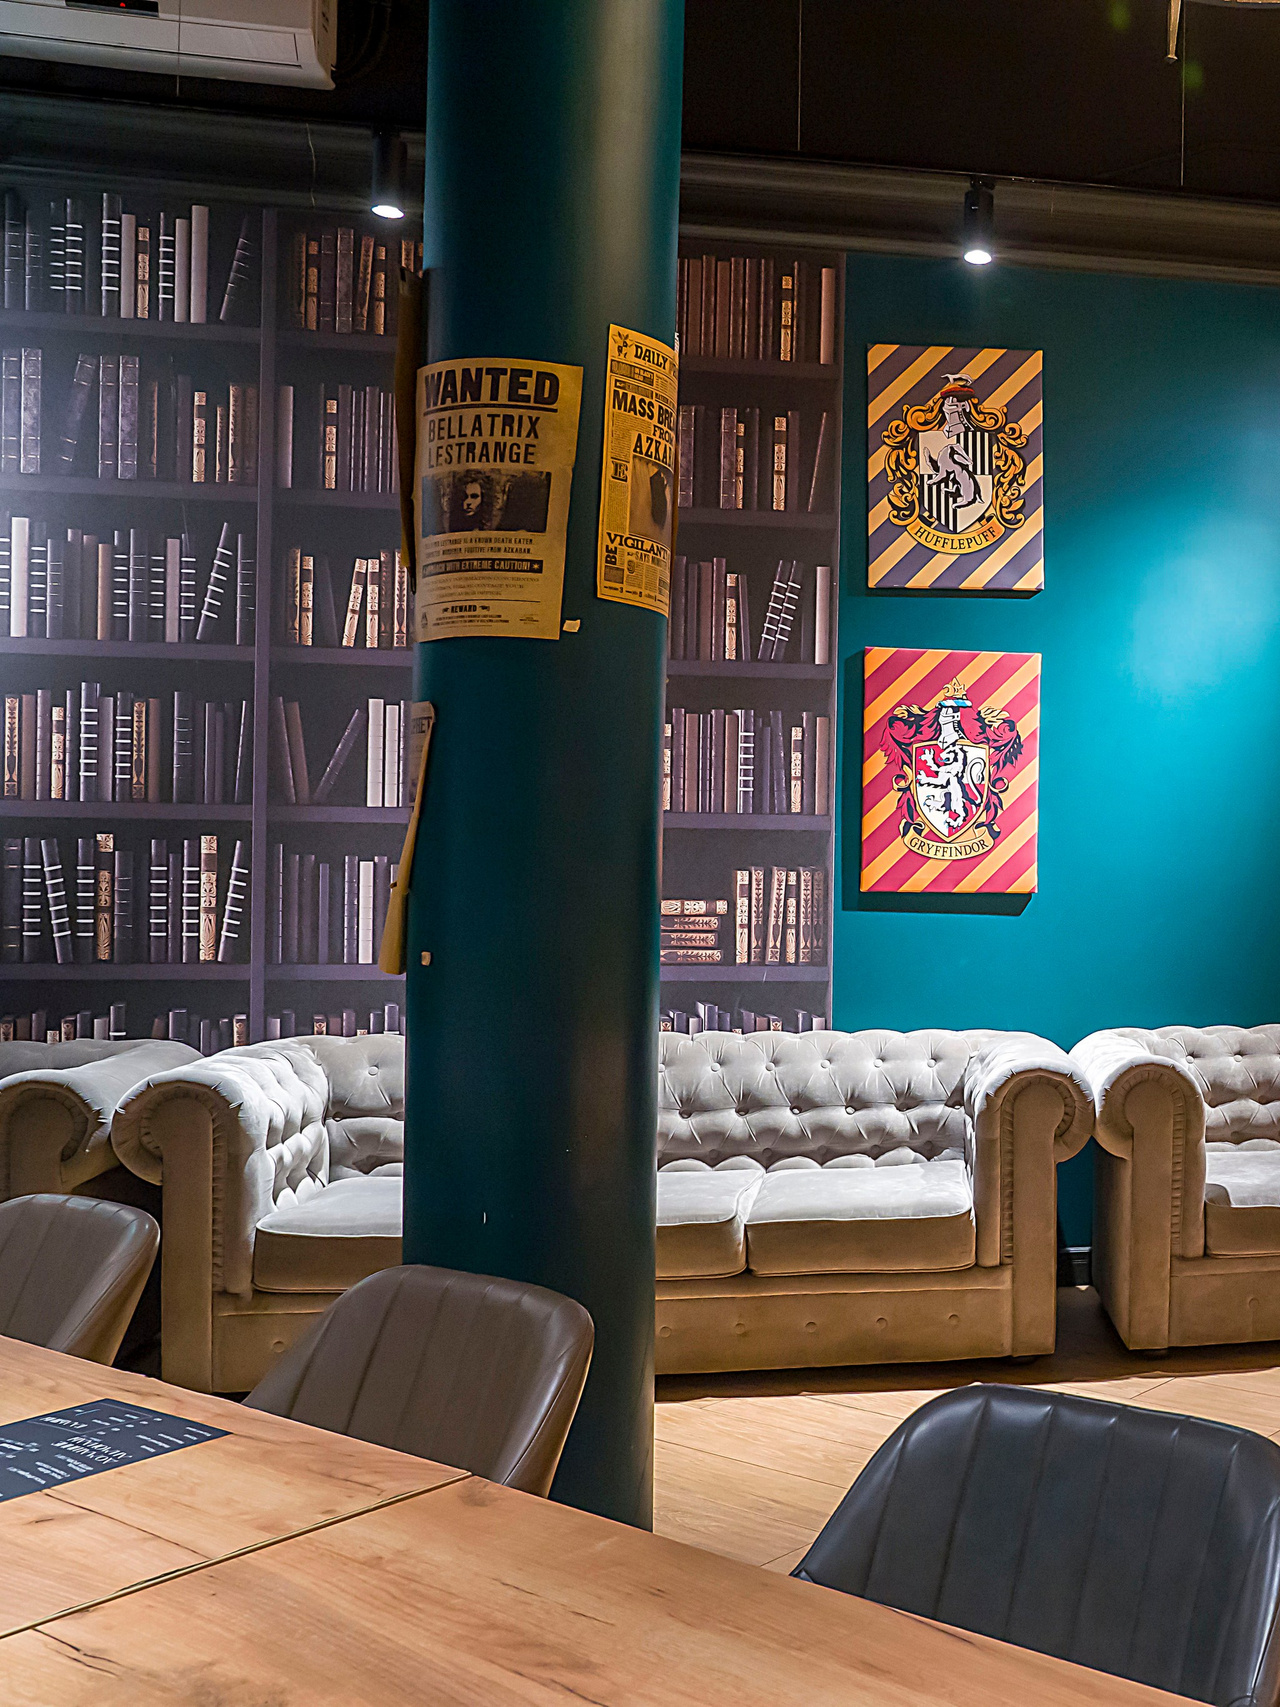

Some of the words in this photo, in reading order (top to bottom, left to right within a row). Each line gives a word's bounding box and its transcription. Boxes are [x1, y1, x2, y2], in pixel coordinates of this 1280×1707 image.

[634, 344, 668, 370] DAILY
[425, 367, 560, 409] WANTED
[612, 389, 655, 421] MASS
[428, 414, 540, 443] BELLATRIX
[428, 442, 537, 469] LESTRANGE
[606, 532, 668, 560] VIGILANT
[914, 525, 998, 550] HUFFLEPUFF
[461, 560, 492, 571] EXTREME
[494, 560, 531, 571] CAUTION!
[450, 604, 477, 613] REWARD
[909, 835, 989, 858] GRYFFINDOR
